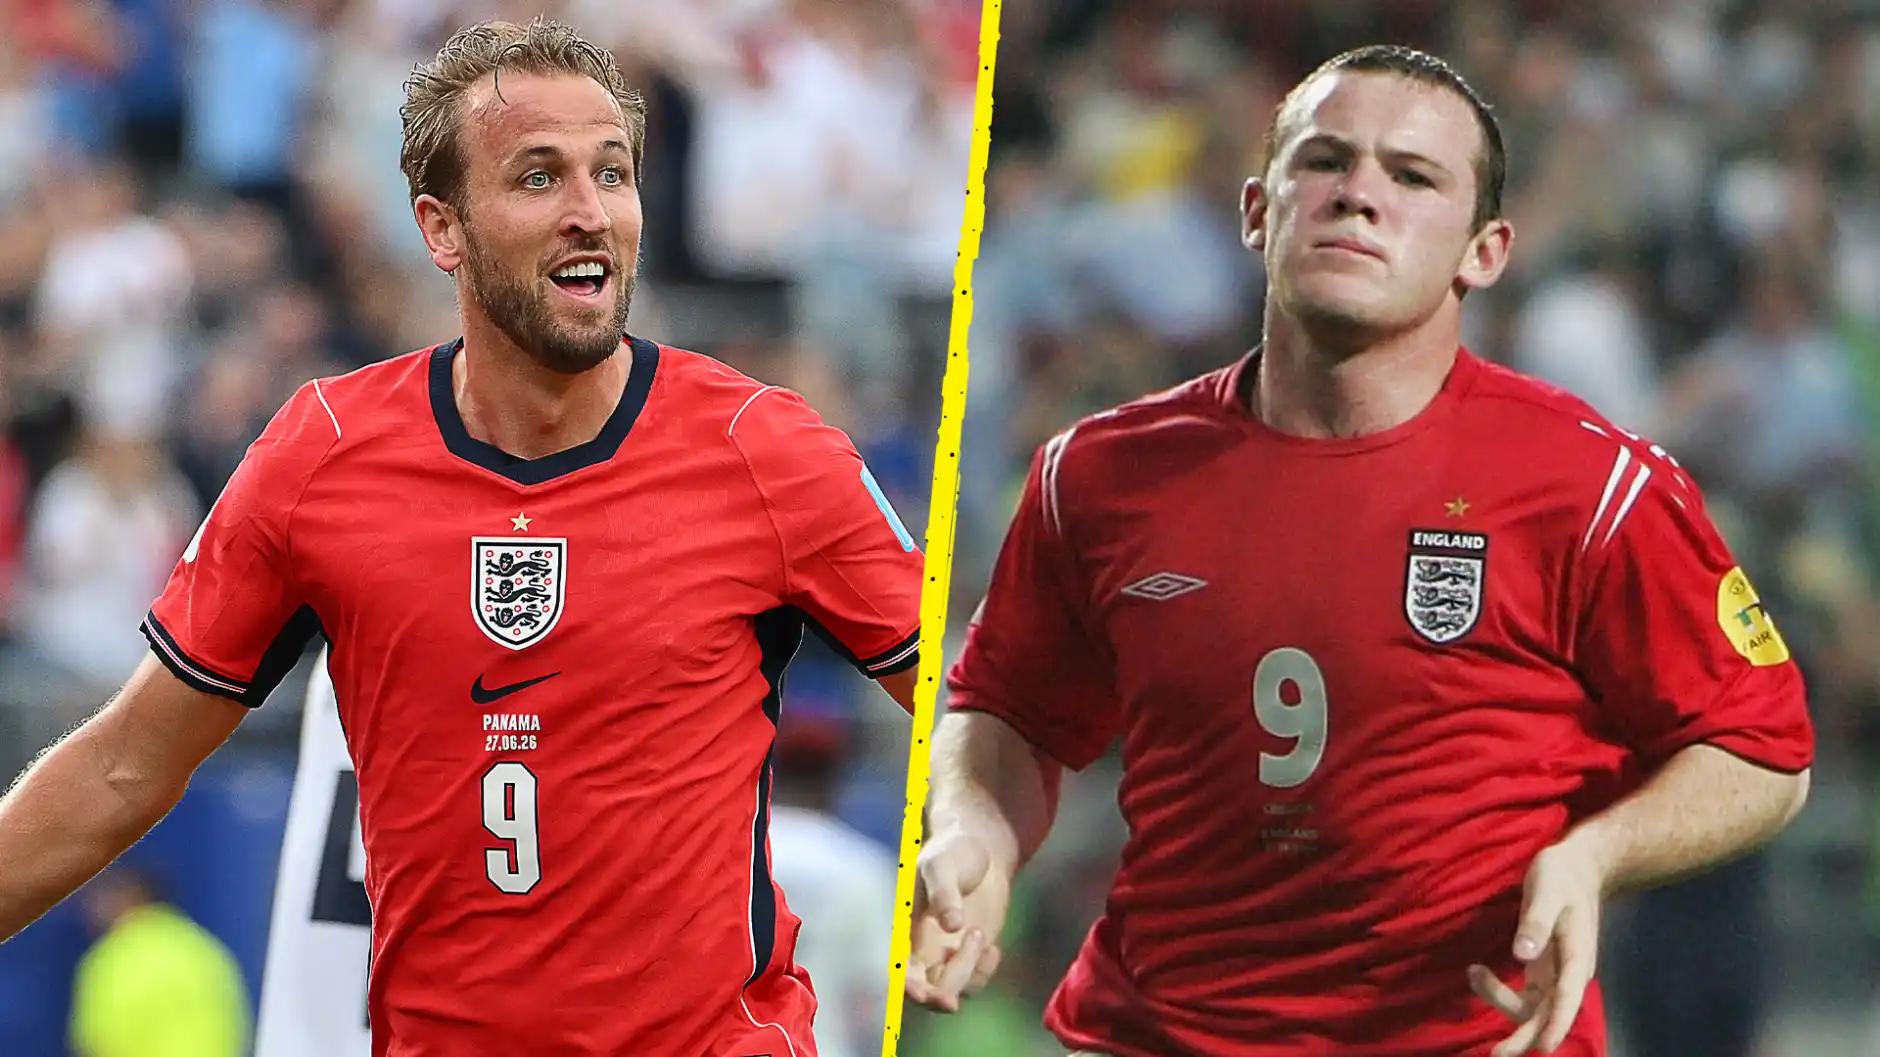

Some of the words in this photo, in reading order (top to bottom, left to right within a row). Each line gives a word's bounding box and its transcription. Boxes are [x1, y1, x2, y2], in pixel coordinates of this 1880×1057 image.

[1413, 532, 1485, 549] ENGLAND
[483, 714, 541, 731] PANAMA
[1252, 647, 1328, 788] 9
[484, 735, 538, 751] 27.06.26
[481, 761, 541, 894] 9
